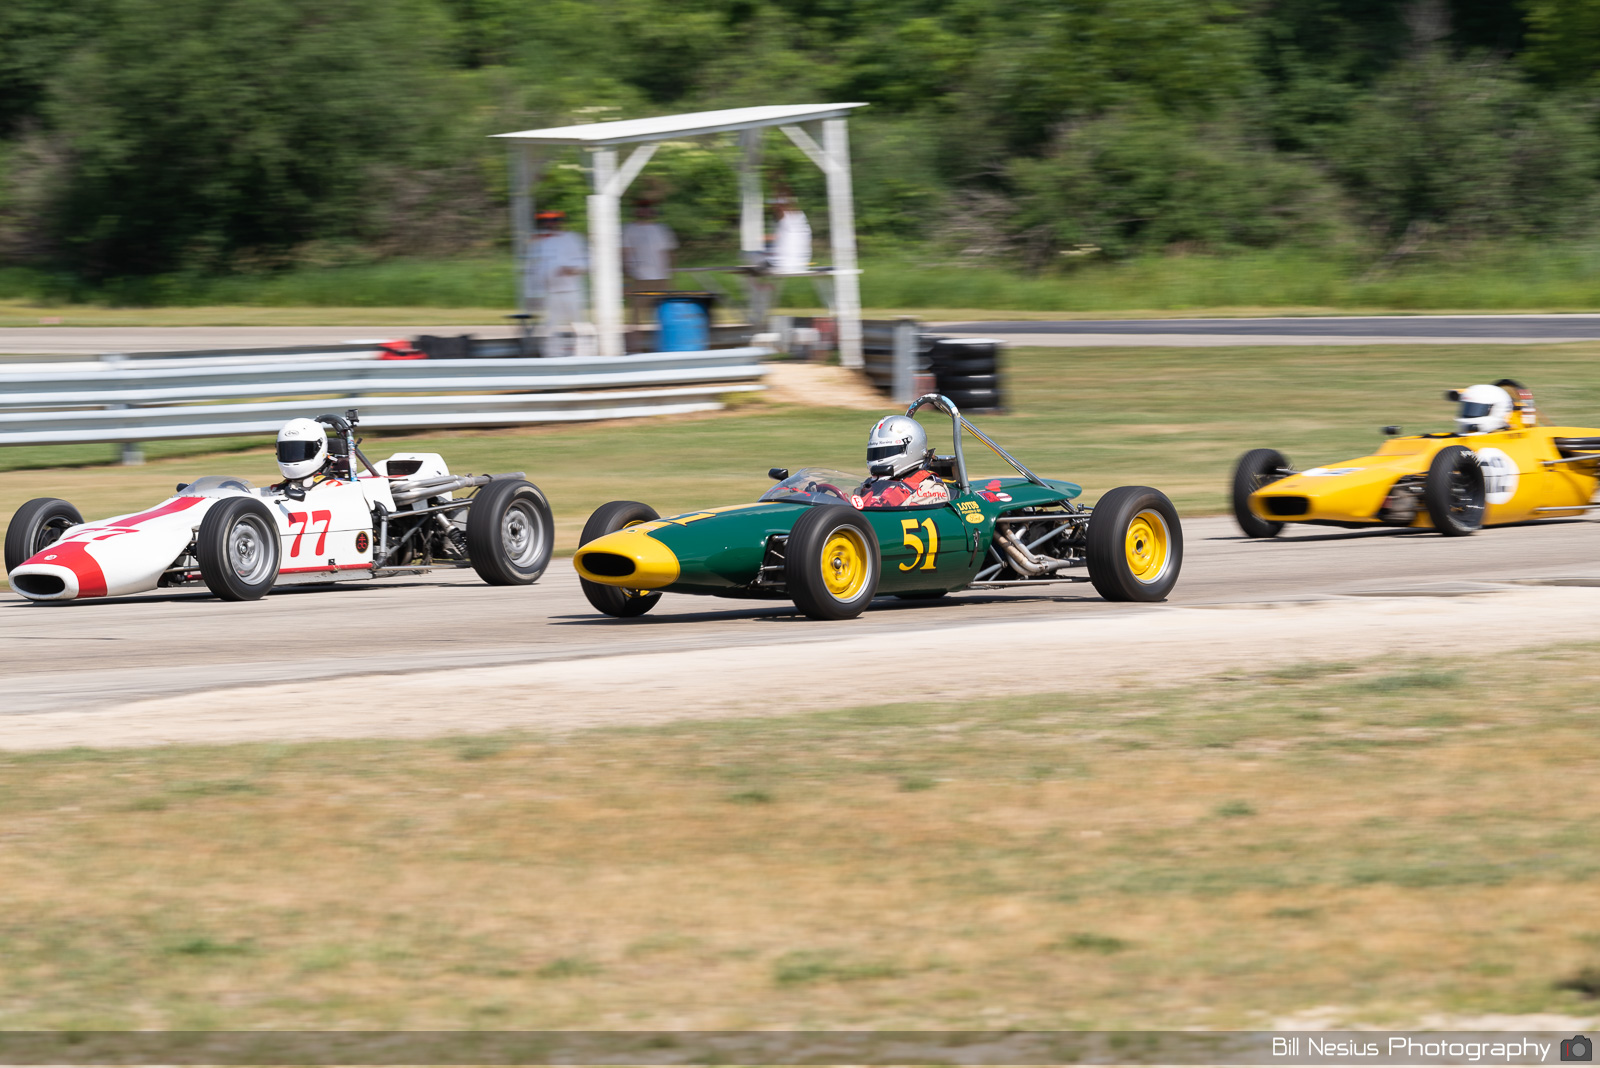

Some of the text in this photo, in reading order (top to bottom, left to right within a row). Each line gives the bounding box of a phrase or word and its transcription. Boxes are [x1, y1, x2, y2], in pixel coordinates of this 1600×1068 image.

[956, 501, 979, 511] LOTUS
[288, 510, 332, 558] 77
[899, 517, 939, 571] 51
